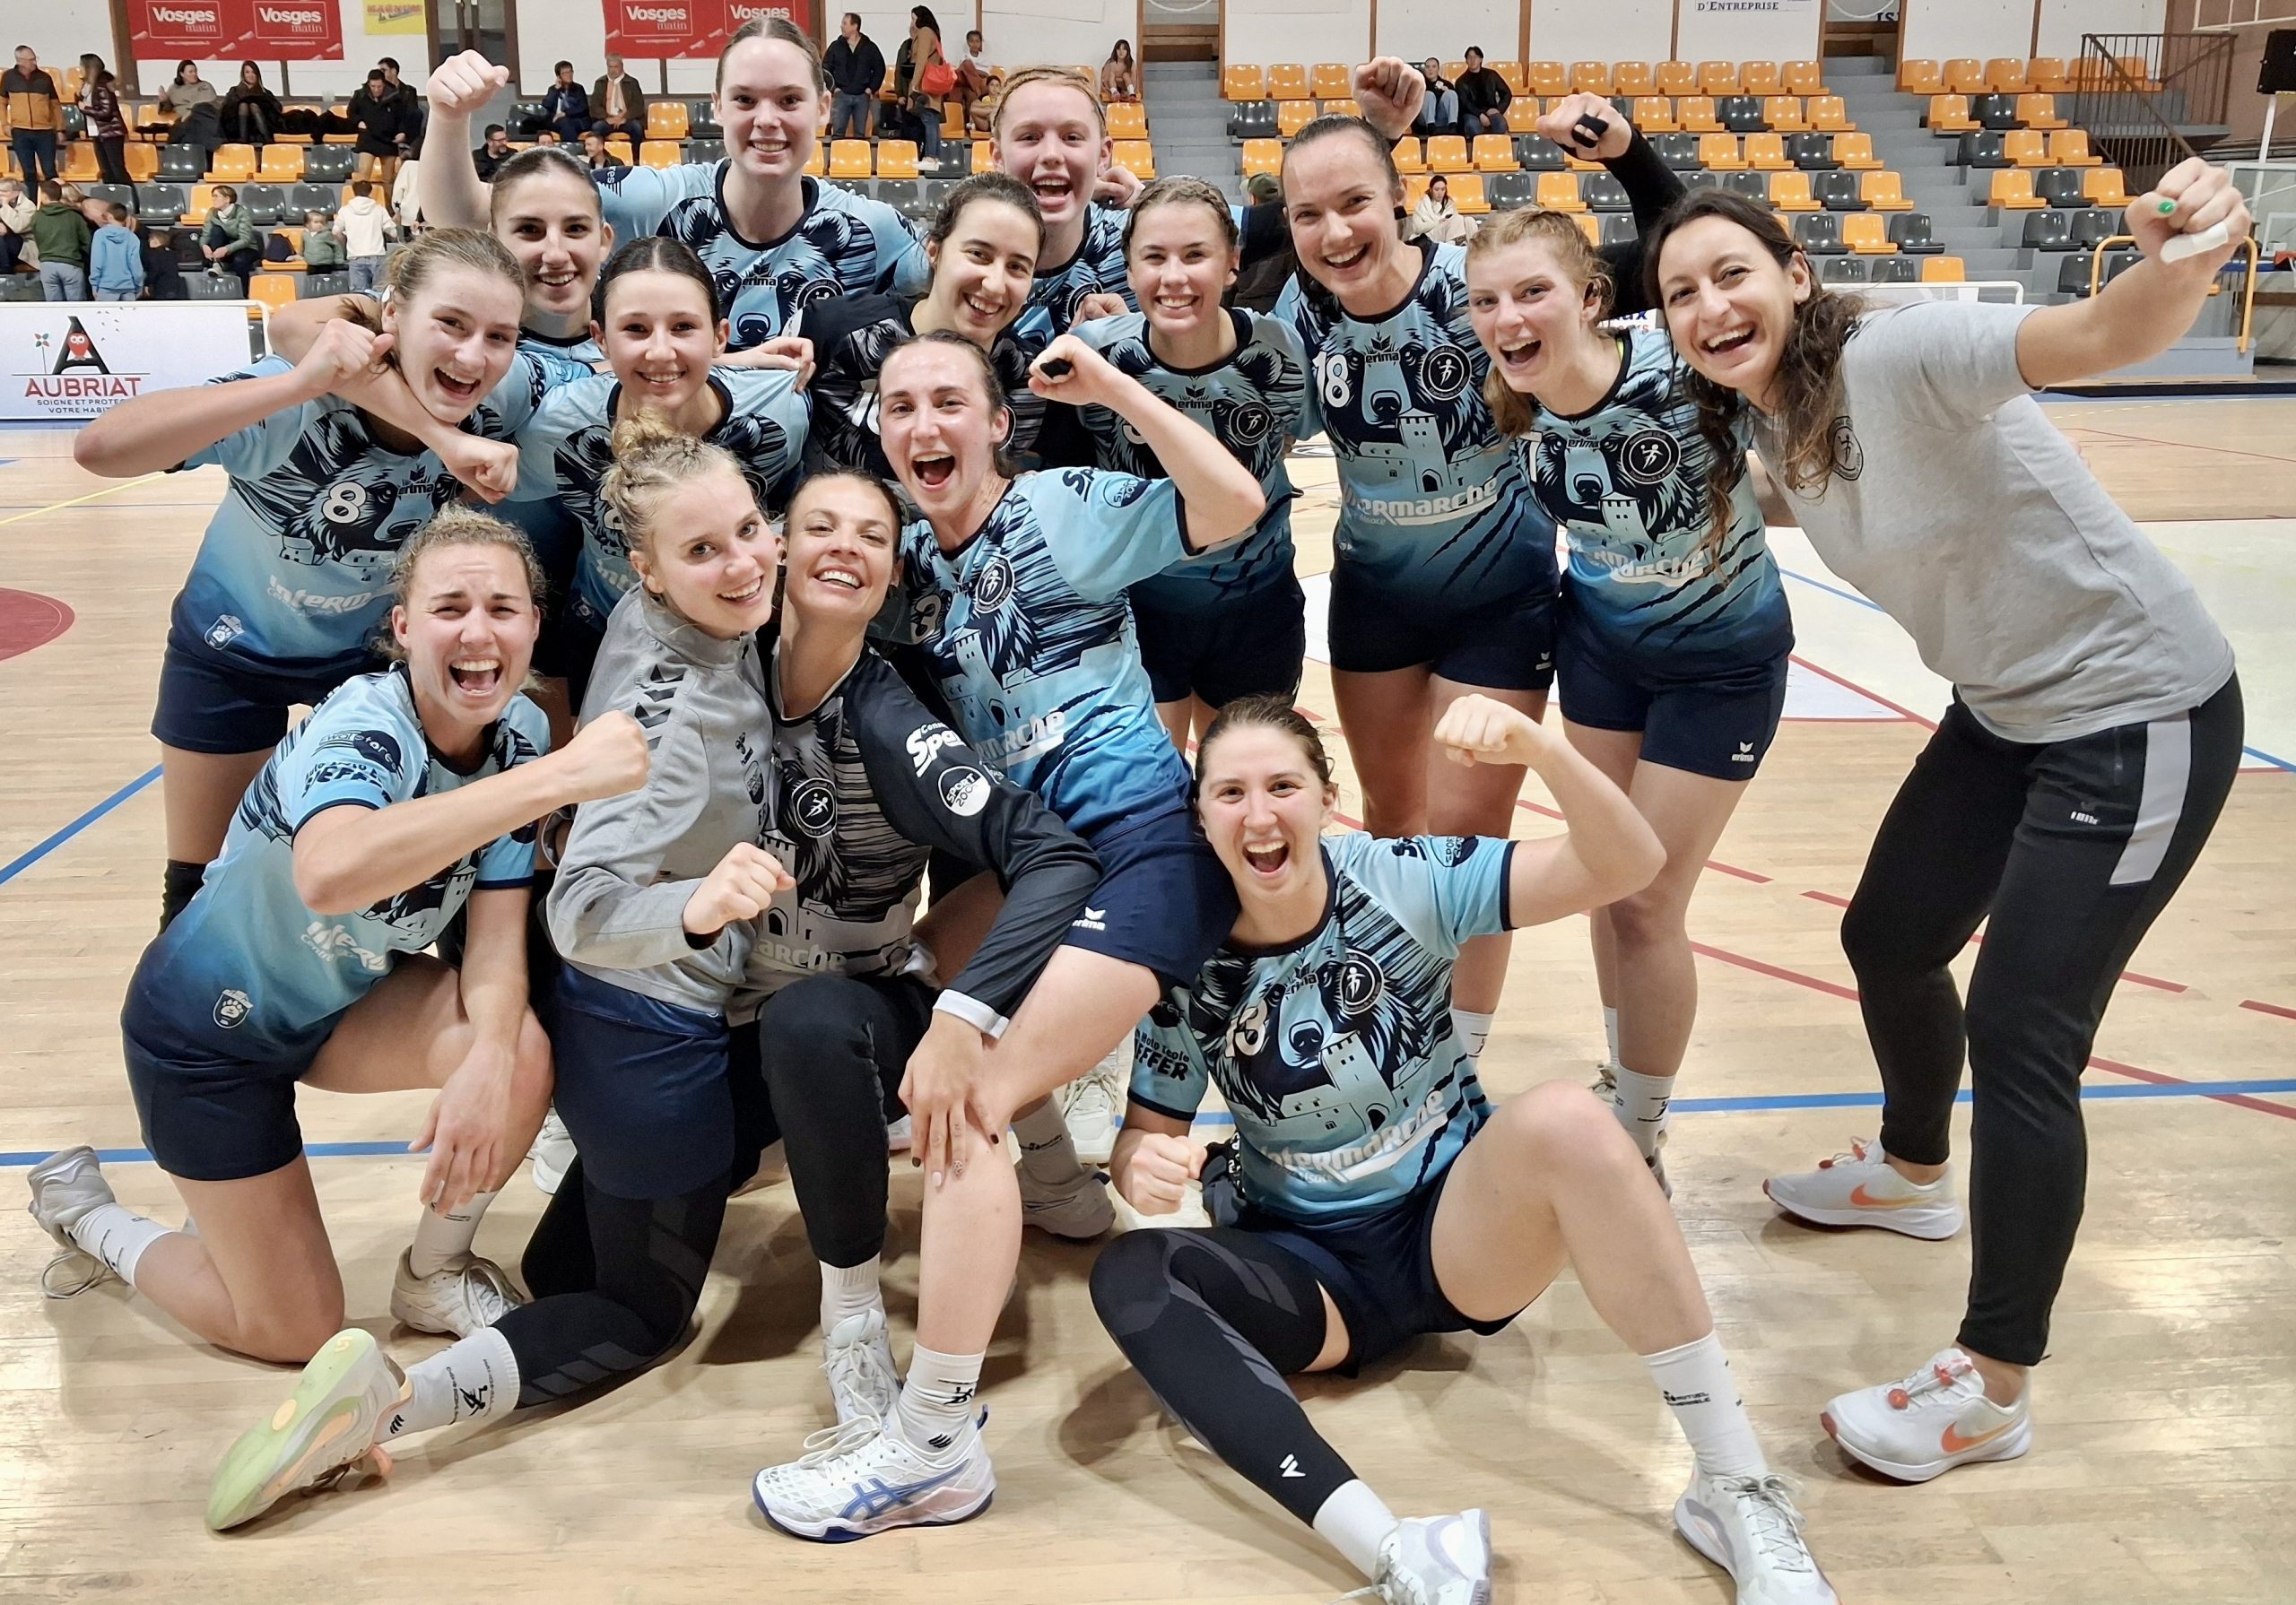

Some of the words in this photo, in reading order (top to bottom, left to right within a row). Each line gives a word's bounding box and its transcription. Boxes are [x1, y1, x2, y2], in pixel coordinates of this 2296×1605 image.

[152, 7, 215, 24] Vosges
[259, 7, 322, 24] Vosges
[626, 5, 687, 22] Vosges
[730, 4, 790, 20] Vosges
[186, 23, 216, 32] matin
[291, 23, 322, 32] matin
[657, 22, 687, 30] matin
[742, 276, 778, 286] erima
[1366, 351, 1400, 363] erima
[25, 377, 141, 397] AUBRIAT
[1312, 350, 1351, 408] 18
[1178, 399, 1213, 409] erima
[1568, 438, 1600, 448] erima
[323, 482, 366, 524] 8
[946, 772, 976, 803] SPORT
[1225, 1000, 1268, 1058] 13
